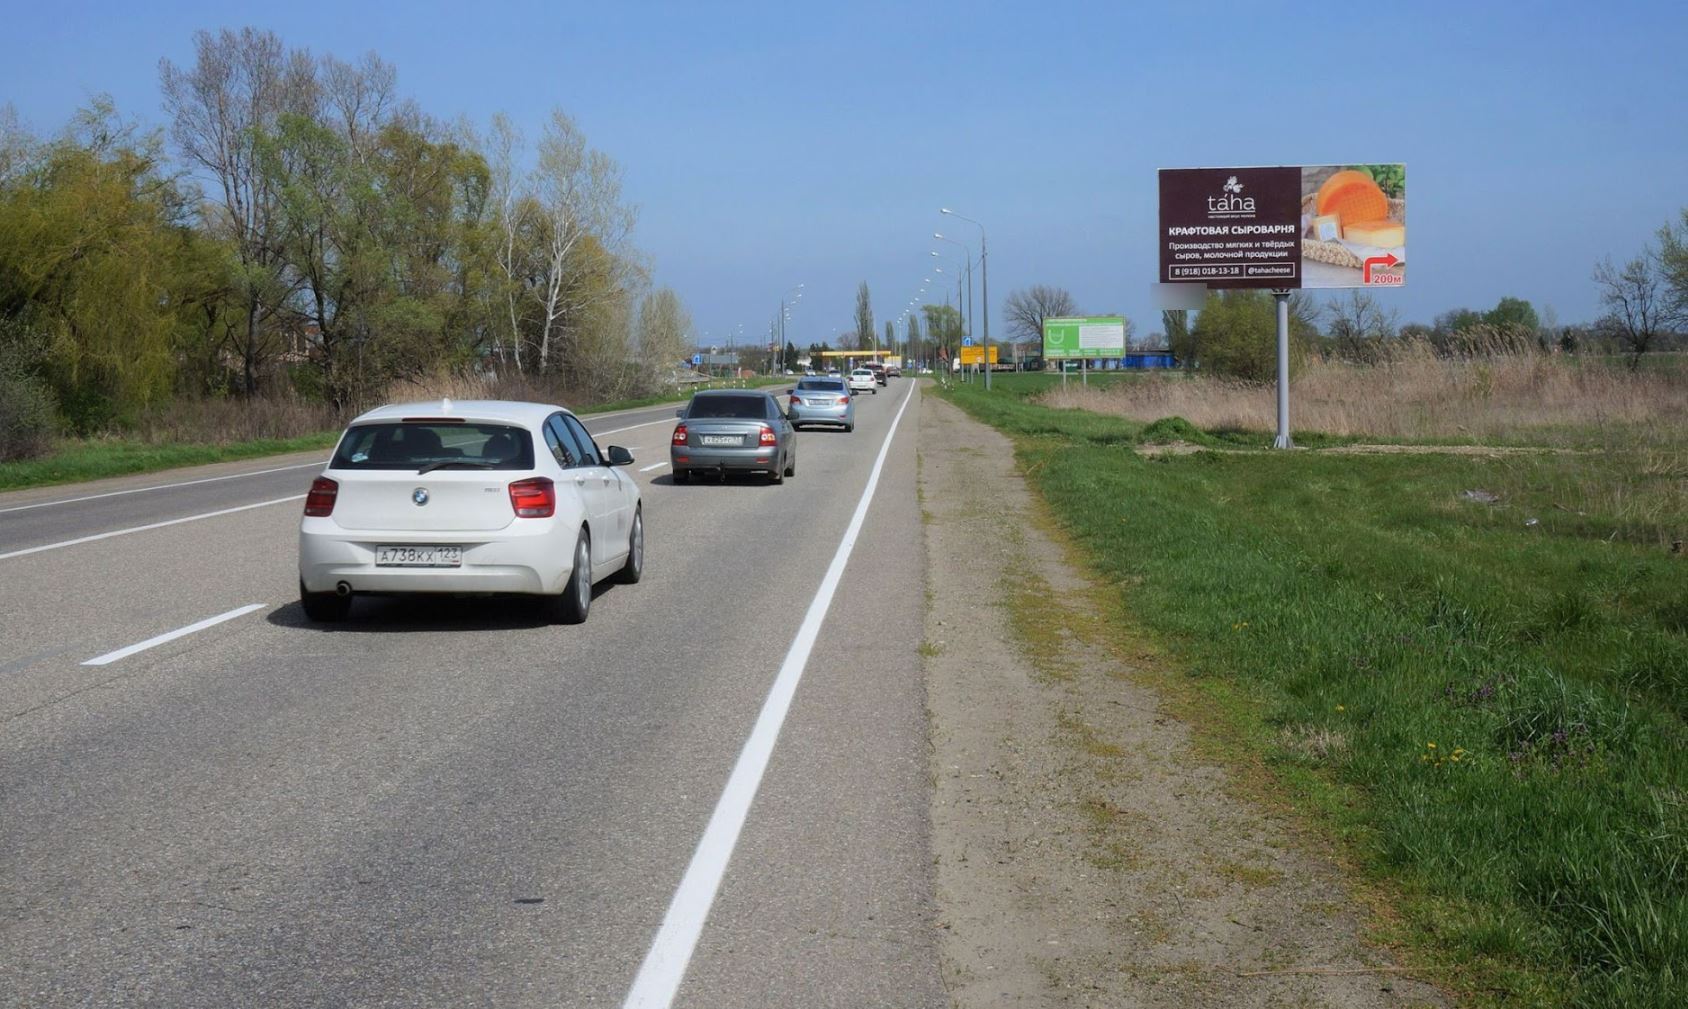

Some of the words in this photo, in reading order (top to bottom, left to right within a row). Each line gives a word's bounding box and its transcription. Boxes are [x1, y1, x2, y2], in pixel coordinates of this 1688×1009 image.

[1207, 193, 1256, 211] táha
[1168, 226, 1229, 236] КРАФТОВАЯ
[1231, 225, 1295, 235] СЫРОВАРНЯ
[1168, 242, 1224, 251] Производство
[1225, 241, 1253, 249] мягких
[1261, 240, 1295, 249] твёрдых
[1175, 252, 1202, 260] сыров,
[1203, 250, 1243, 259] молочной
[1245, 250, 1288, 259] продукции
[1181, 267, 1200, 276] (918)
[1201, 266, 1240, 275] 018-13-18
[1247, 266, 1291, 275] @tahacheese
[438, 547, 458, 559] 123
